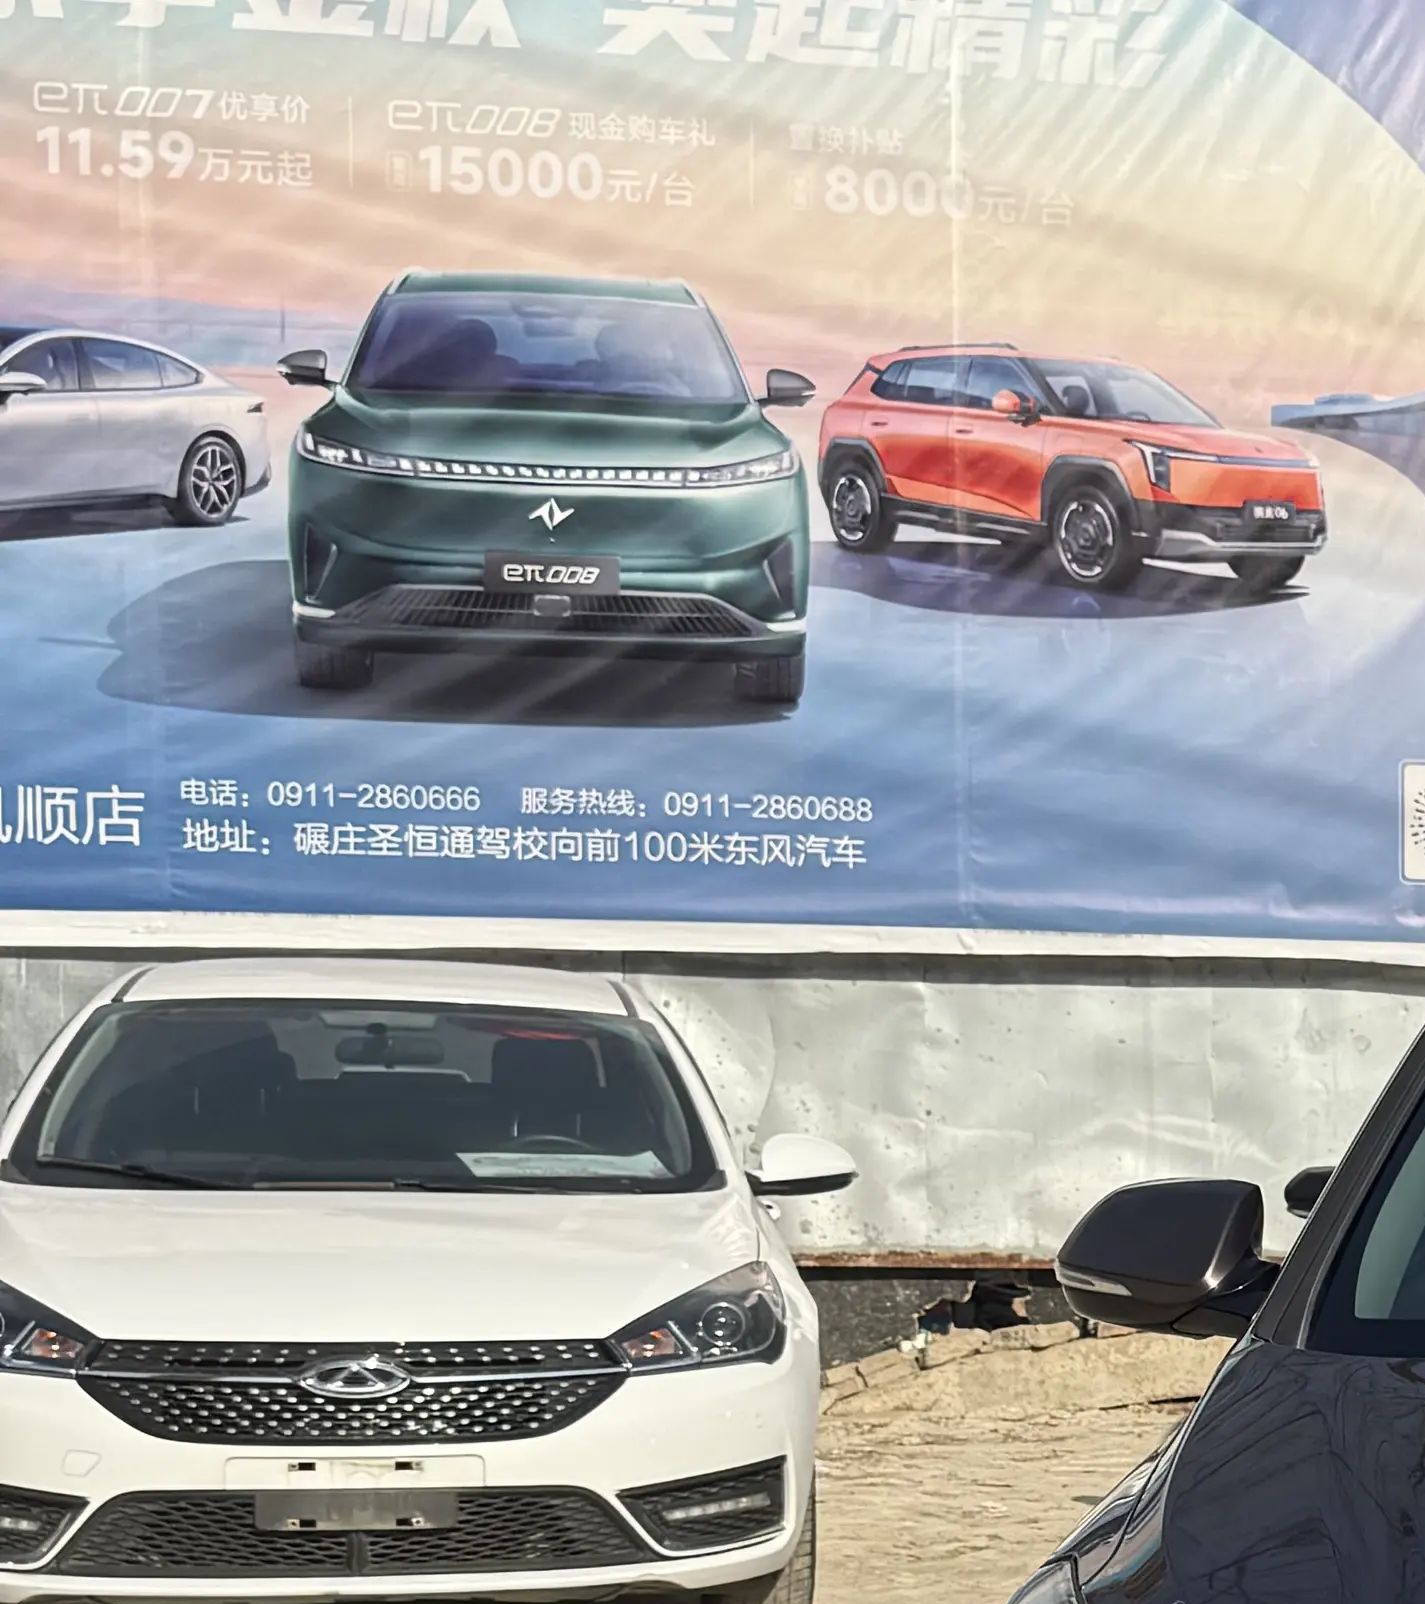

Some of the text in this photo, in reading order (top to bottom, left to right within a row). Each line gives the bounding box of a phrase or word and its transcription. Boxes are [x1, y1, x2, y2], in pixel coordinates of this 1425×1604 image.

[567, 112, 716, 147] 现金购车礼
